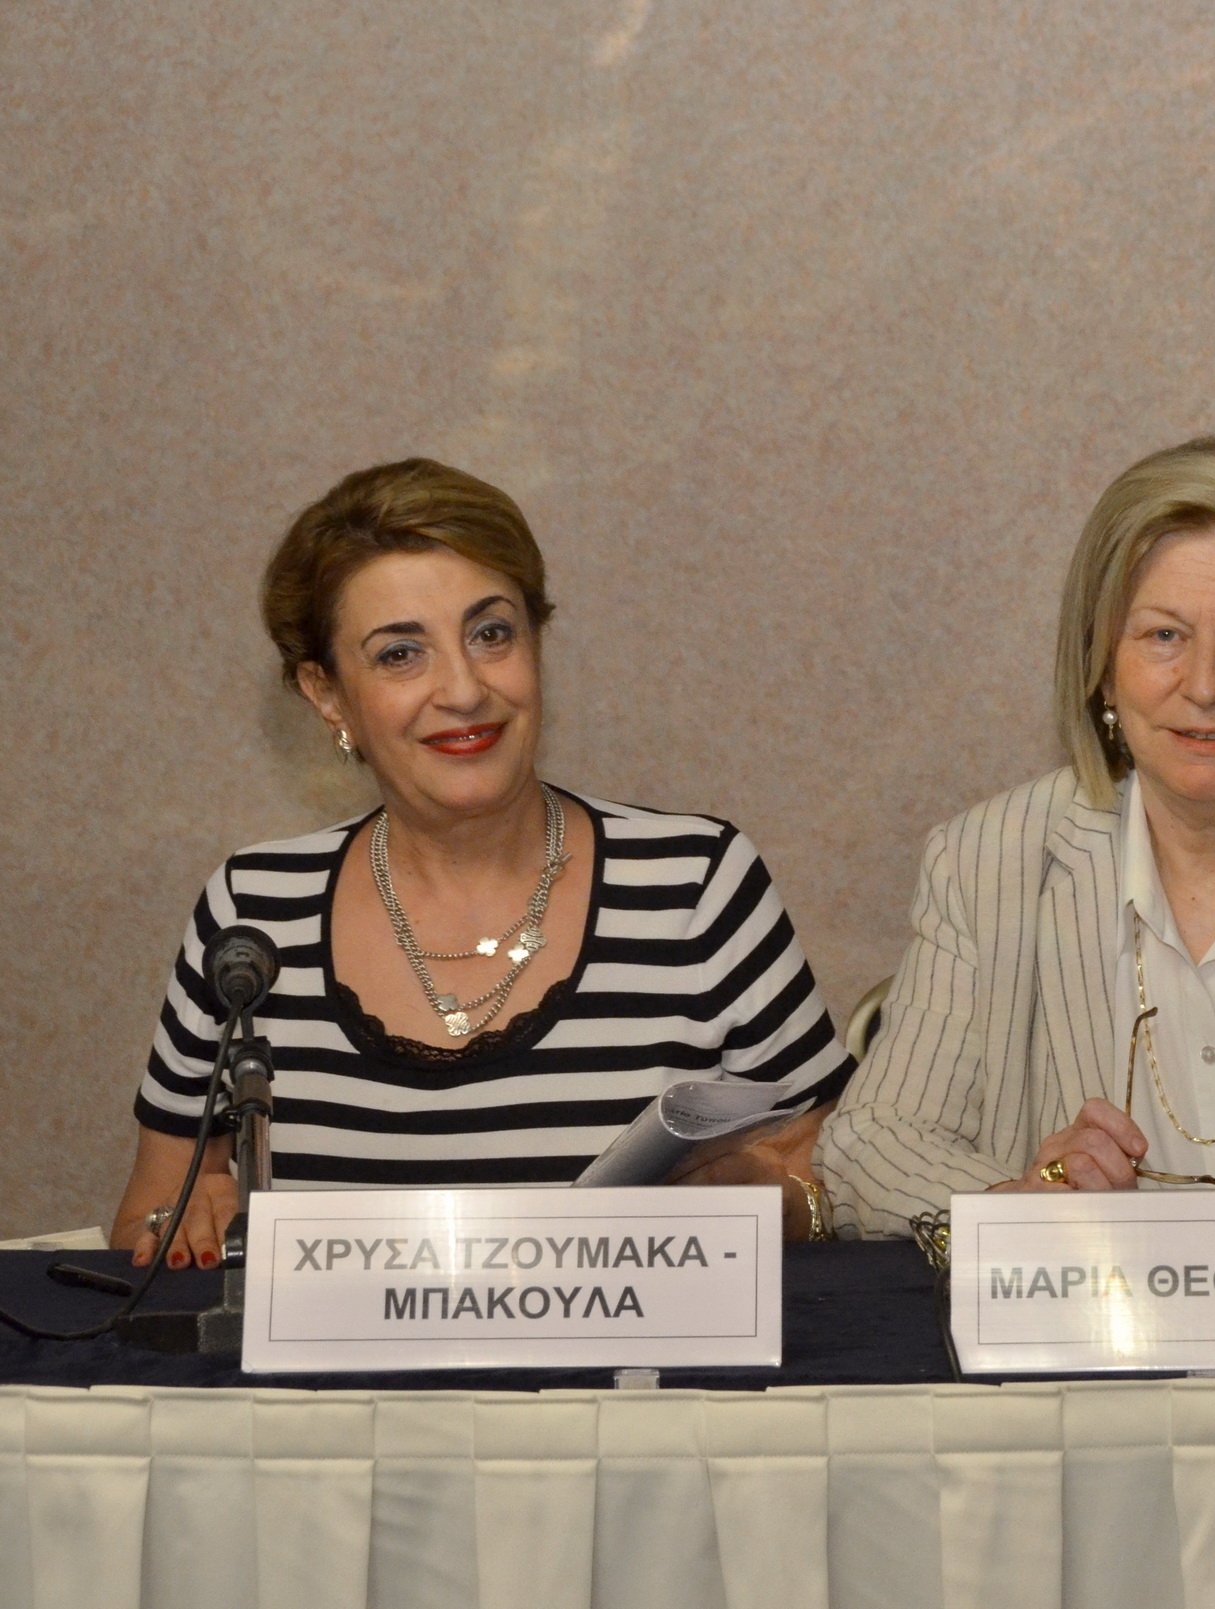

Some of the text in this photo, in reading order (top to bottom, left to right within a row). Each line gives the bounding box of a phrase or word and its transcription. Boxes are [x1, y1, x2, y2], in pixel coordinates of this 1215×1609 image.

[293, 1235, 738, 1271] ΧΡΥΣΑ ΤΖΟΥΜΑΚΑ -
[989, 1265, 1134, 1300] ΜΑΡΙΑ
[383, 1285, 645, 1320] ΜΠΑΚΟΥΛΑ
